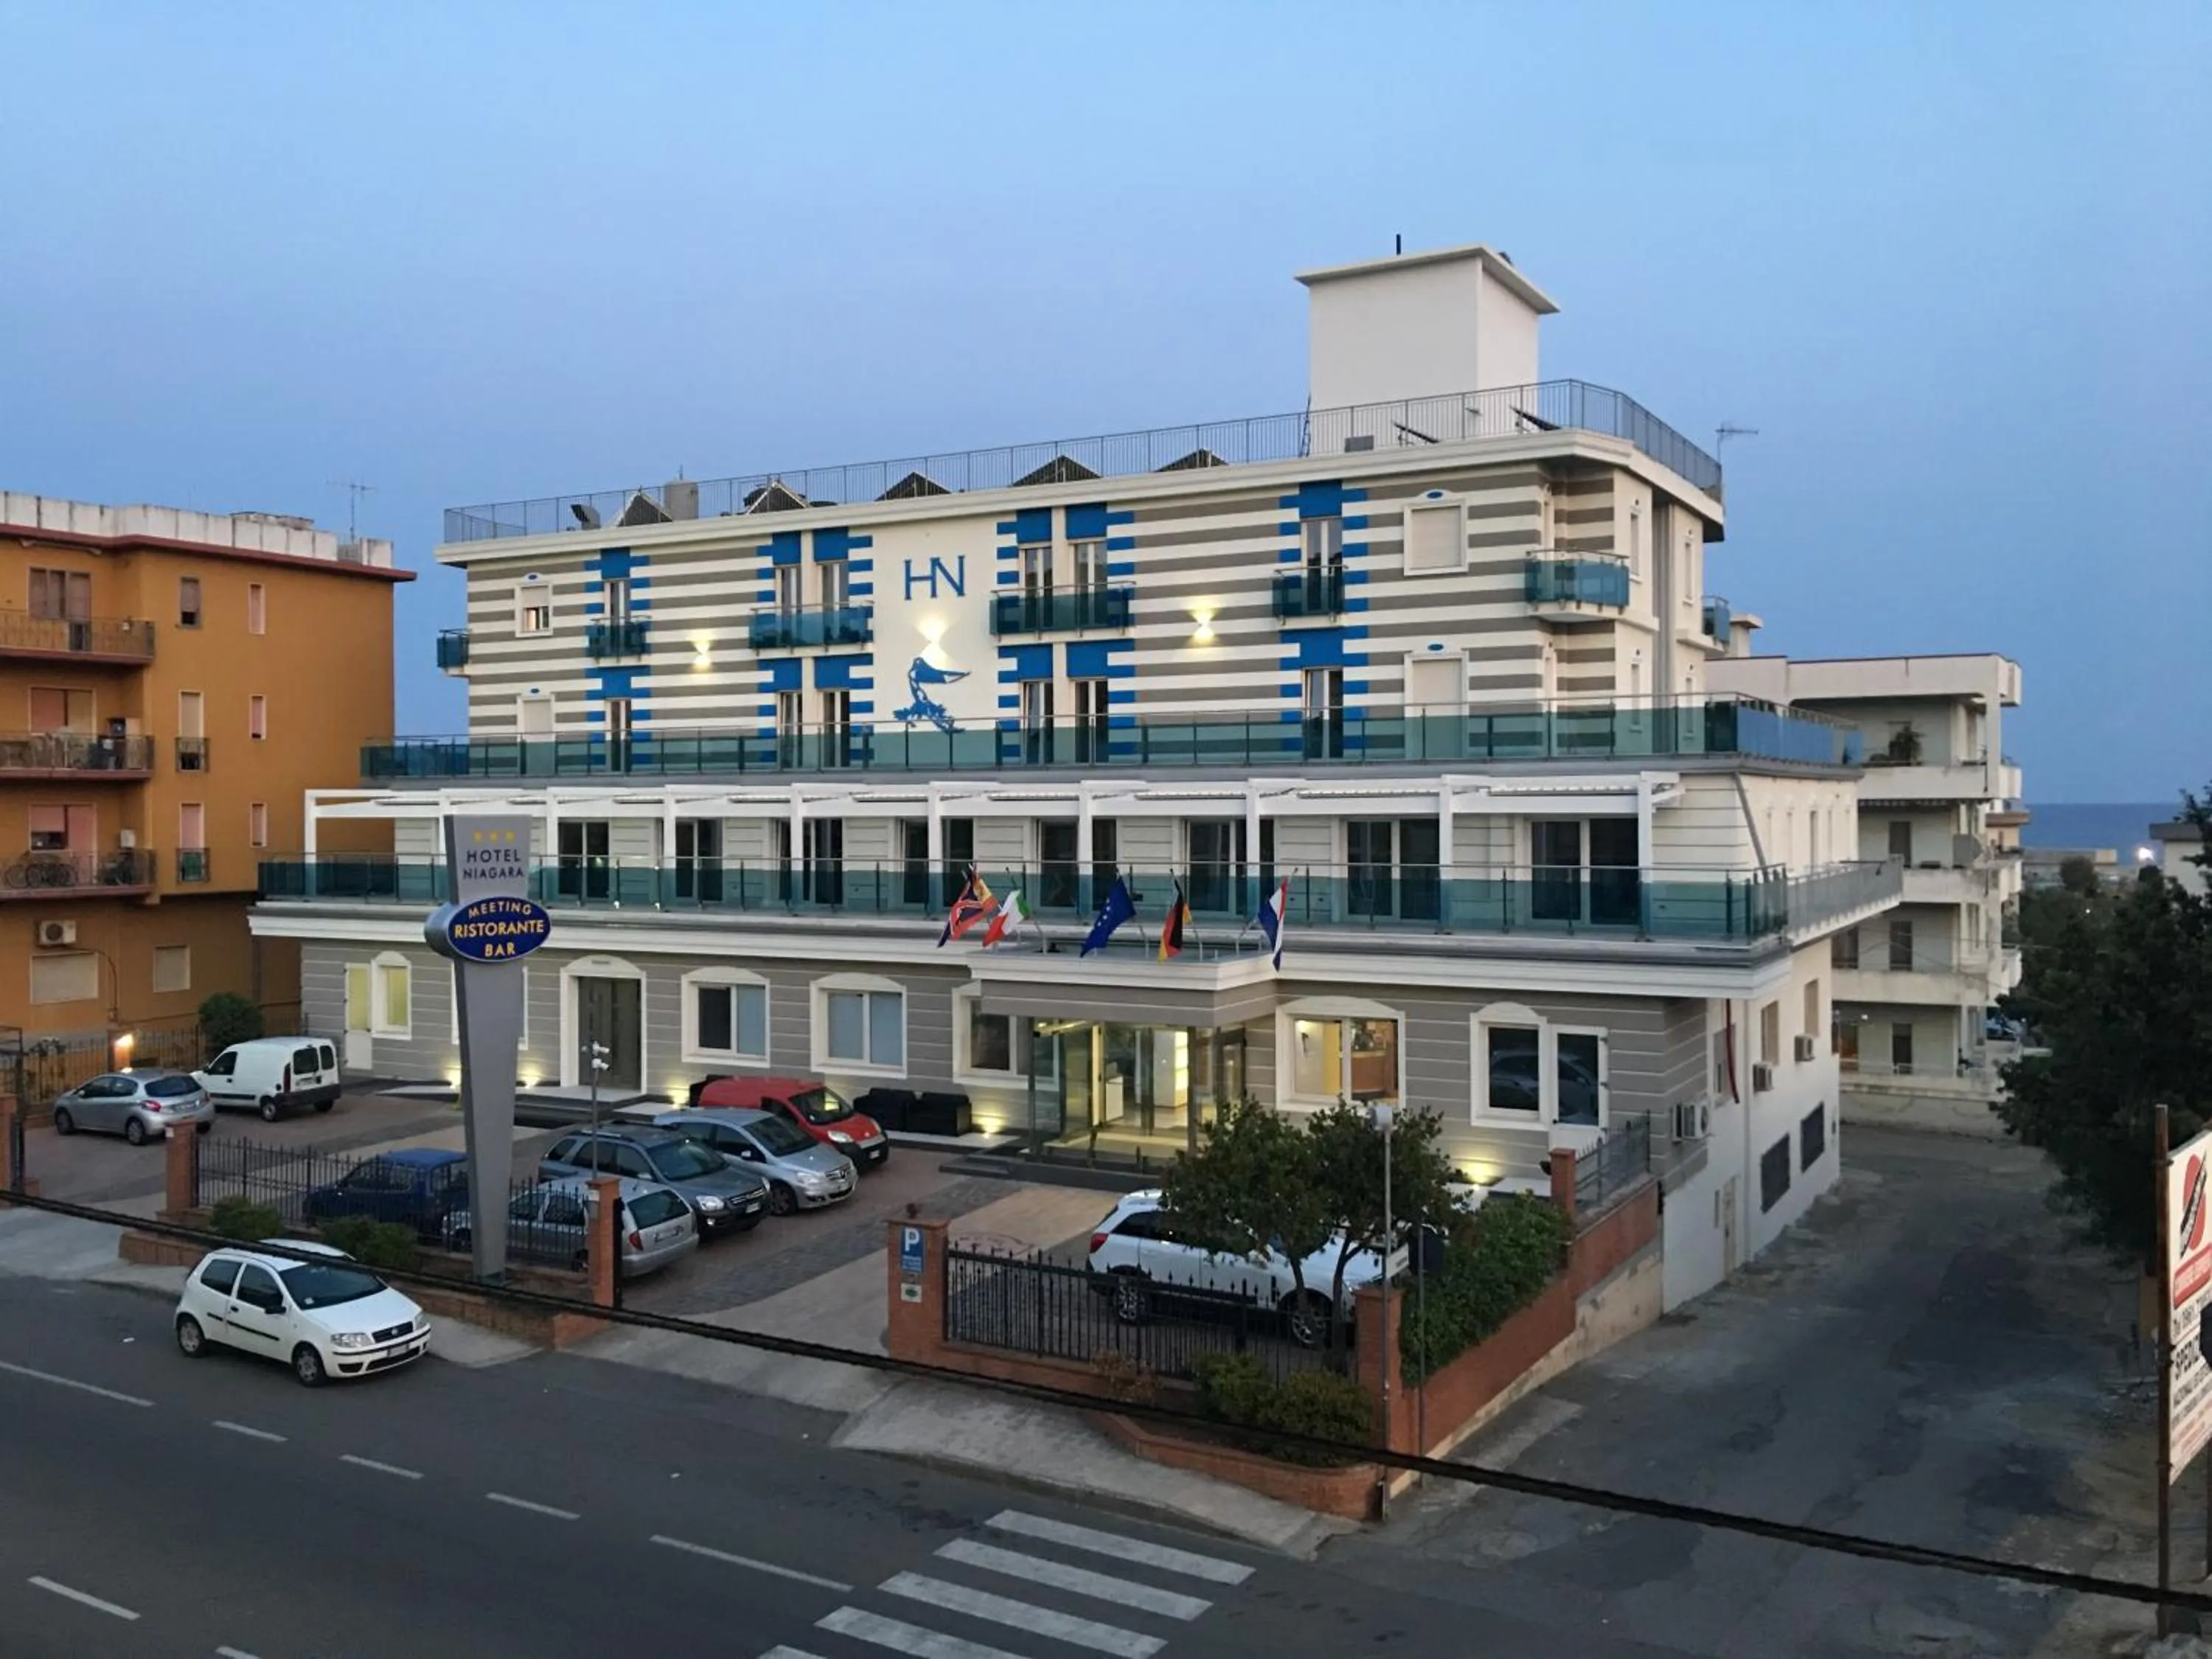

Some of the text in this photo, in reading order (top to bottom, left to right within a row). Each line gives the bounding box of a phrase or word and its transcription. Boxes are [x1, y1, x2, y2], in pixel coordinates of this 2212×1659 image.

[904, 554, 965, 600] HN
[467, 849, 521, 863] HOTEL
[462, 866, 525, 880] NIAGARA
[468, 900, 532, 919] MEETING
[454, 919, 544, 939] RISTORANTE
[484, 942, 515, 957] BAR
[905, 1226, 920, 1251] P
